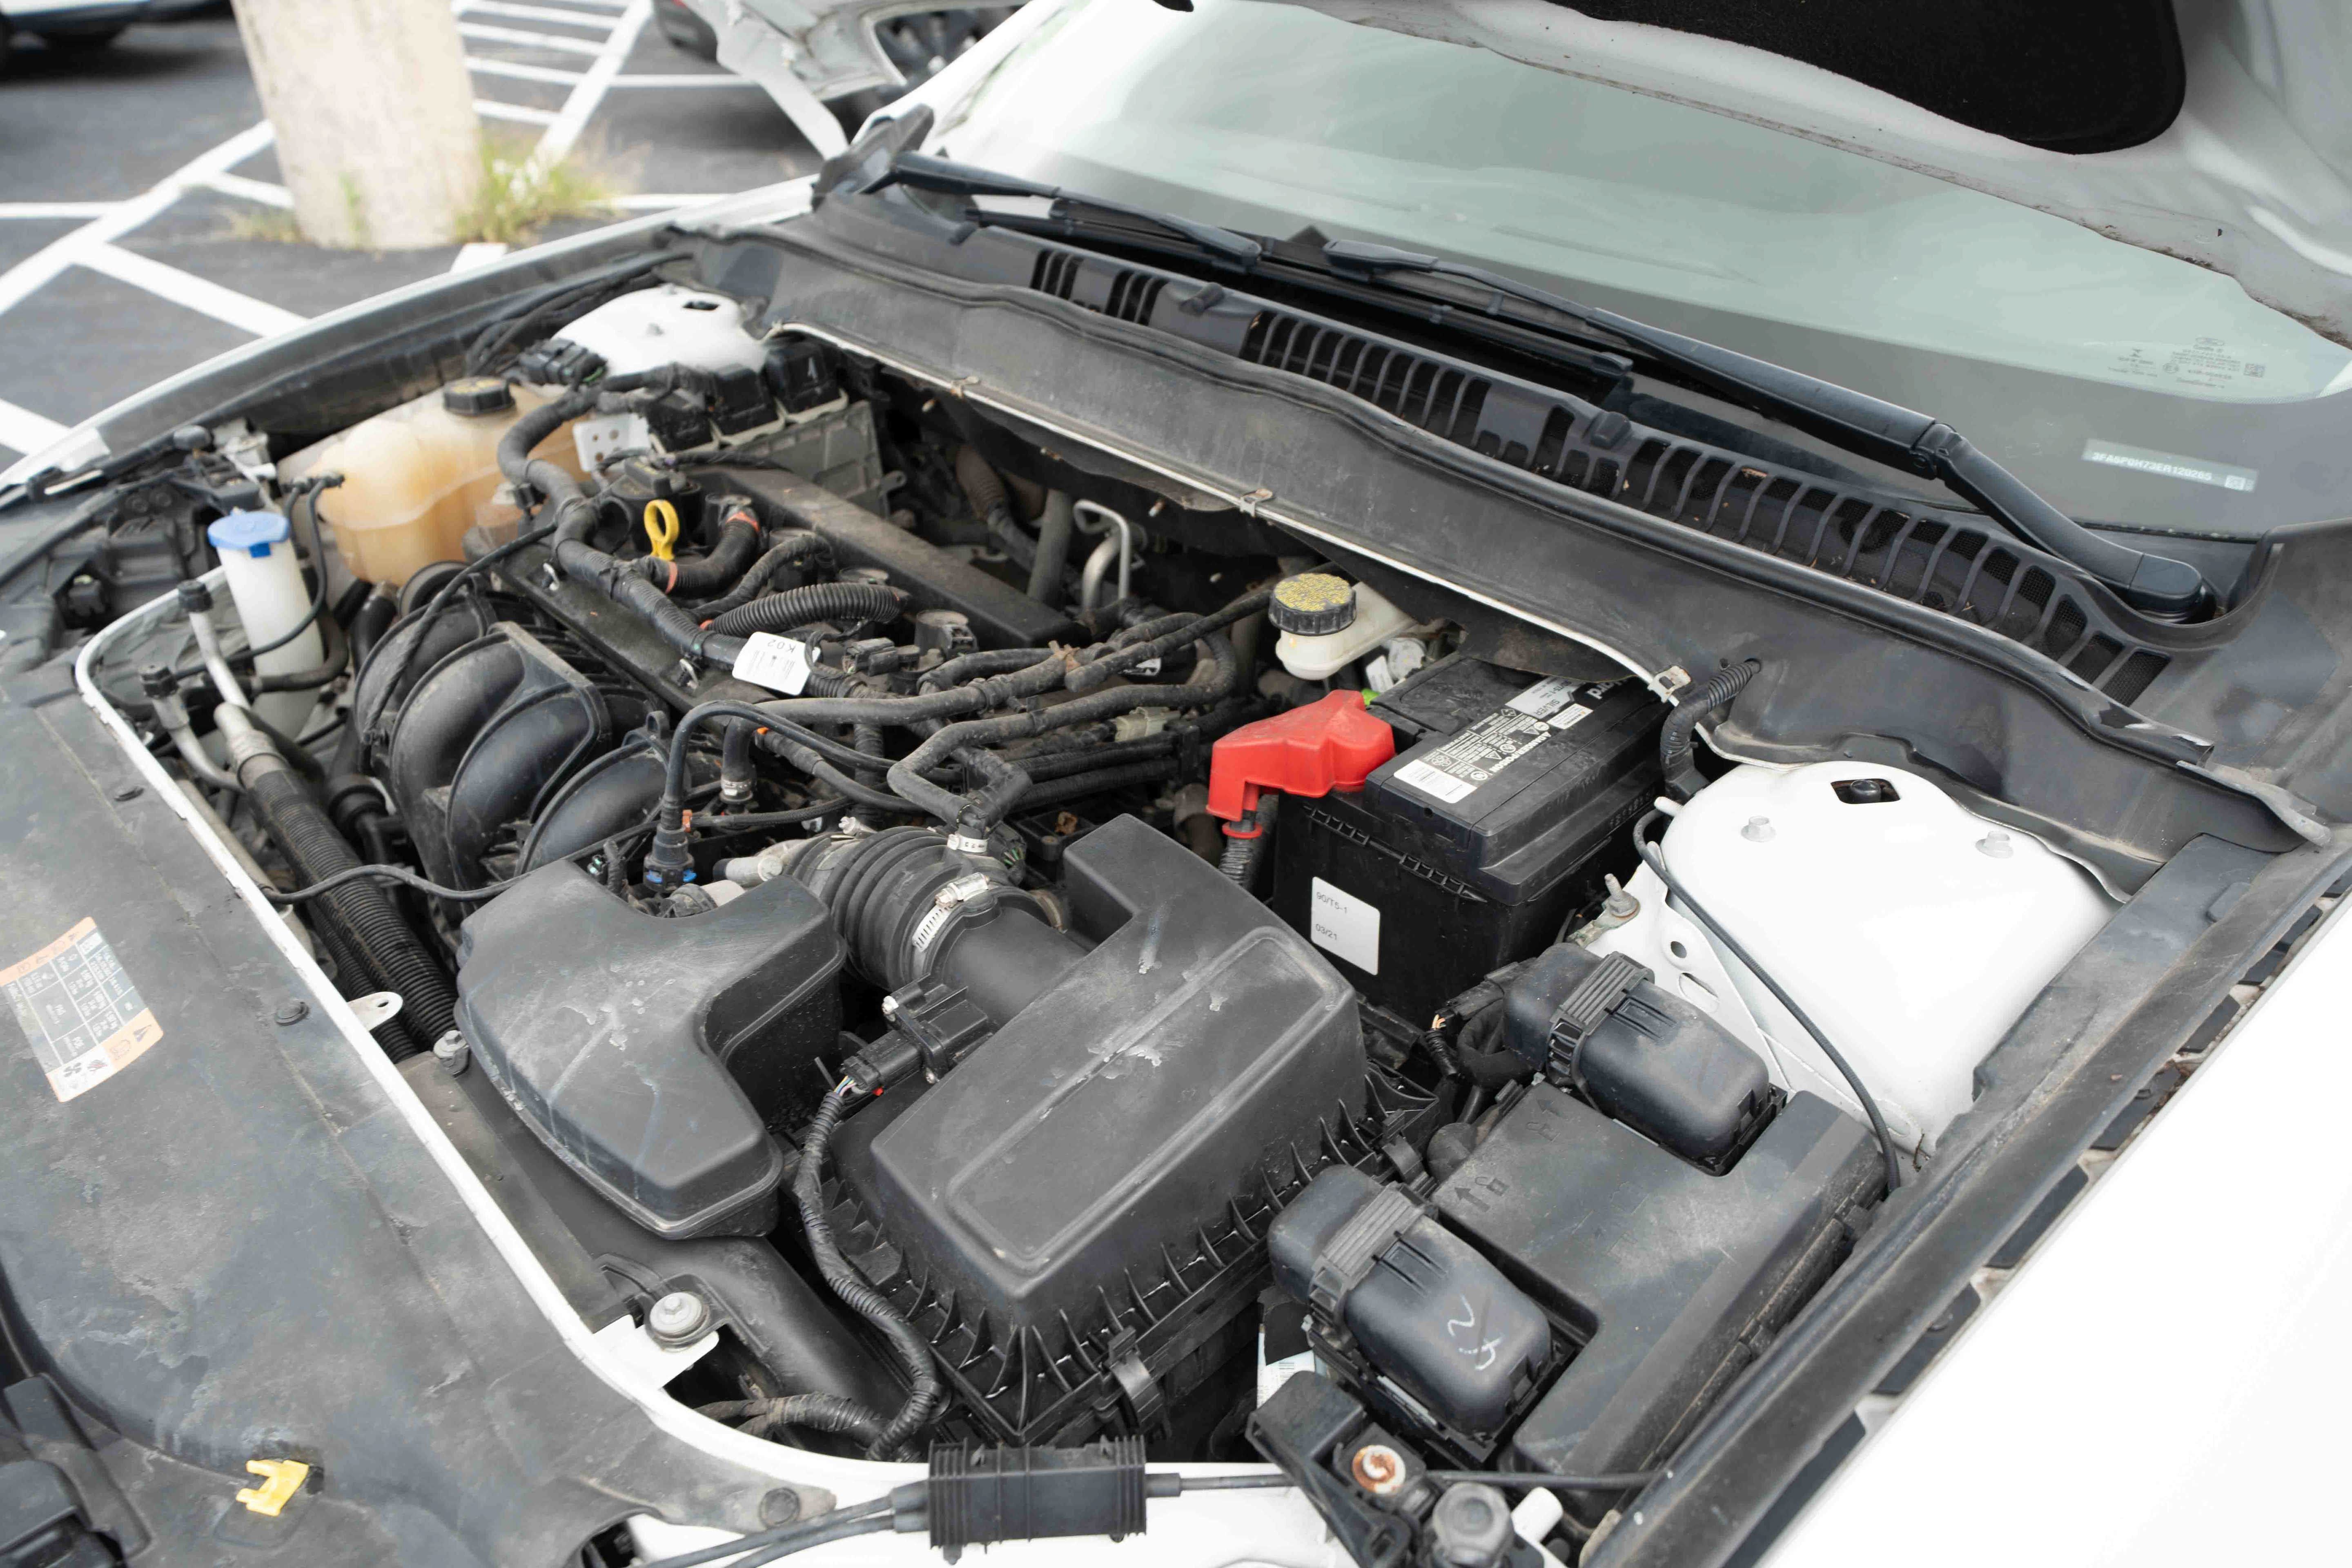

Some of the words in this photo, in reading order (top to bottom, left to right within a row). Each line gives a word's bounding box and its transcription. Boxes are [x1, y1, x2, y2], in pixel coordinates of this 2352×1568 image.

[1535, 699, 1560, 715] SILVER
[1489, 734, 1547, 773] DANGER/POISON
[1315, 924, 1337, 940] 03/21
